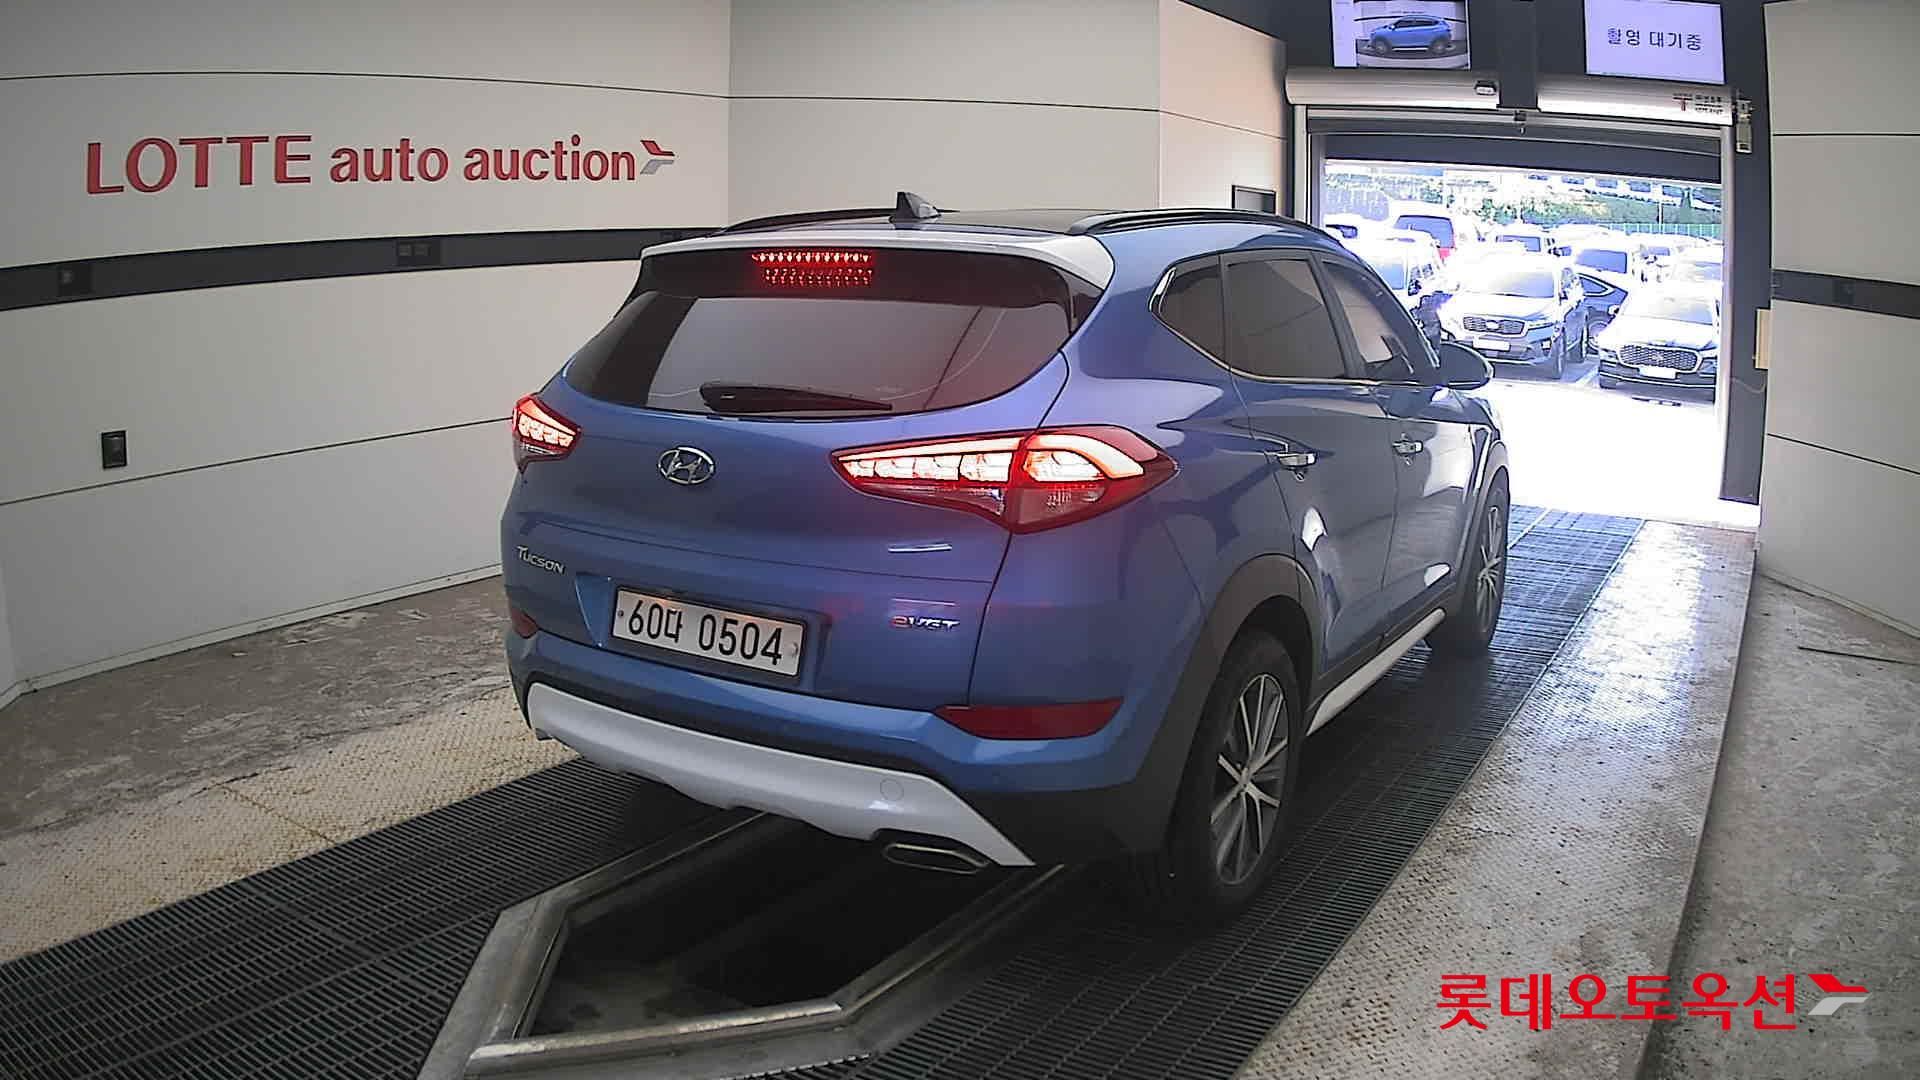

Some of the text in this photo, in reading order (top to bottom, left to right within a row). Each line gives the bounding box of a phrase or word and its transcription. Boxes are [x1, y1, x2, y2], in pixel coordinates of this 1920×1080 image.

[1649, 31, 1702, 51] 대기중
[86, 134, 636, 194] LOTTE auto auction
[628, 600, 783, 666] 60다 0504
